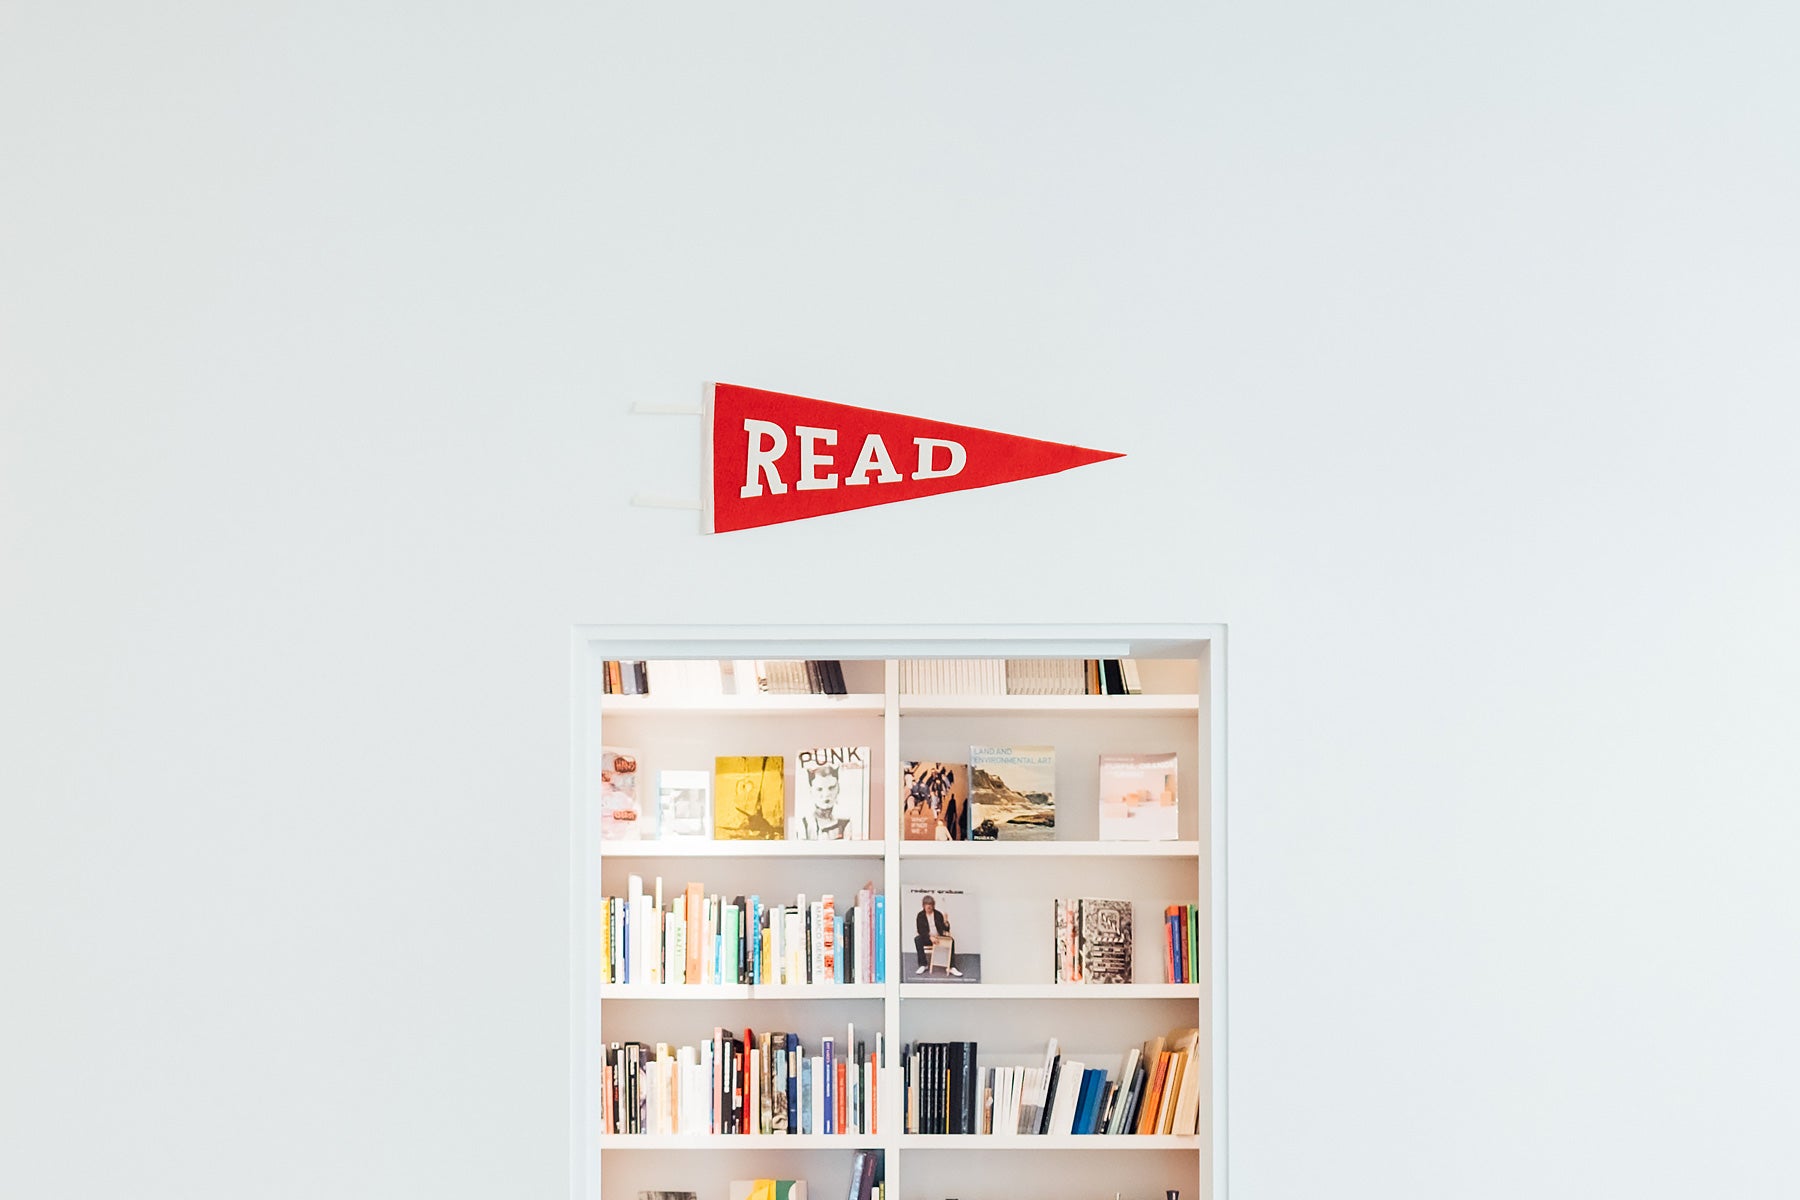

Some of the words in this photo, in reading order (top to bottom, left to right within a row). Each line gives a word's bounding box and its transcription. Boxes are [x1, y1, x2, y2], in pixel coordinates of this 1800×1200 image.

[740, 418, 967, 499] READ
[799, 747, 862, 768] PUNK
[973, 747, 994, 755] LAND
[996, 747, 1012, 755] AND
[973, 756, 1036, 765] ENVIRONMENTAL
[1037, 756, 1052, 764] ART
